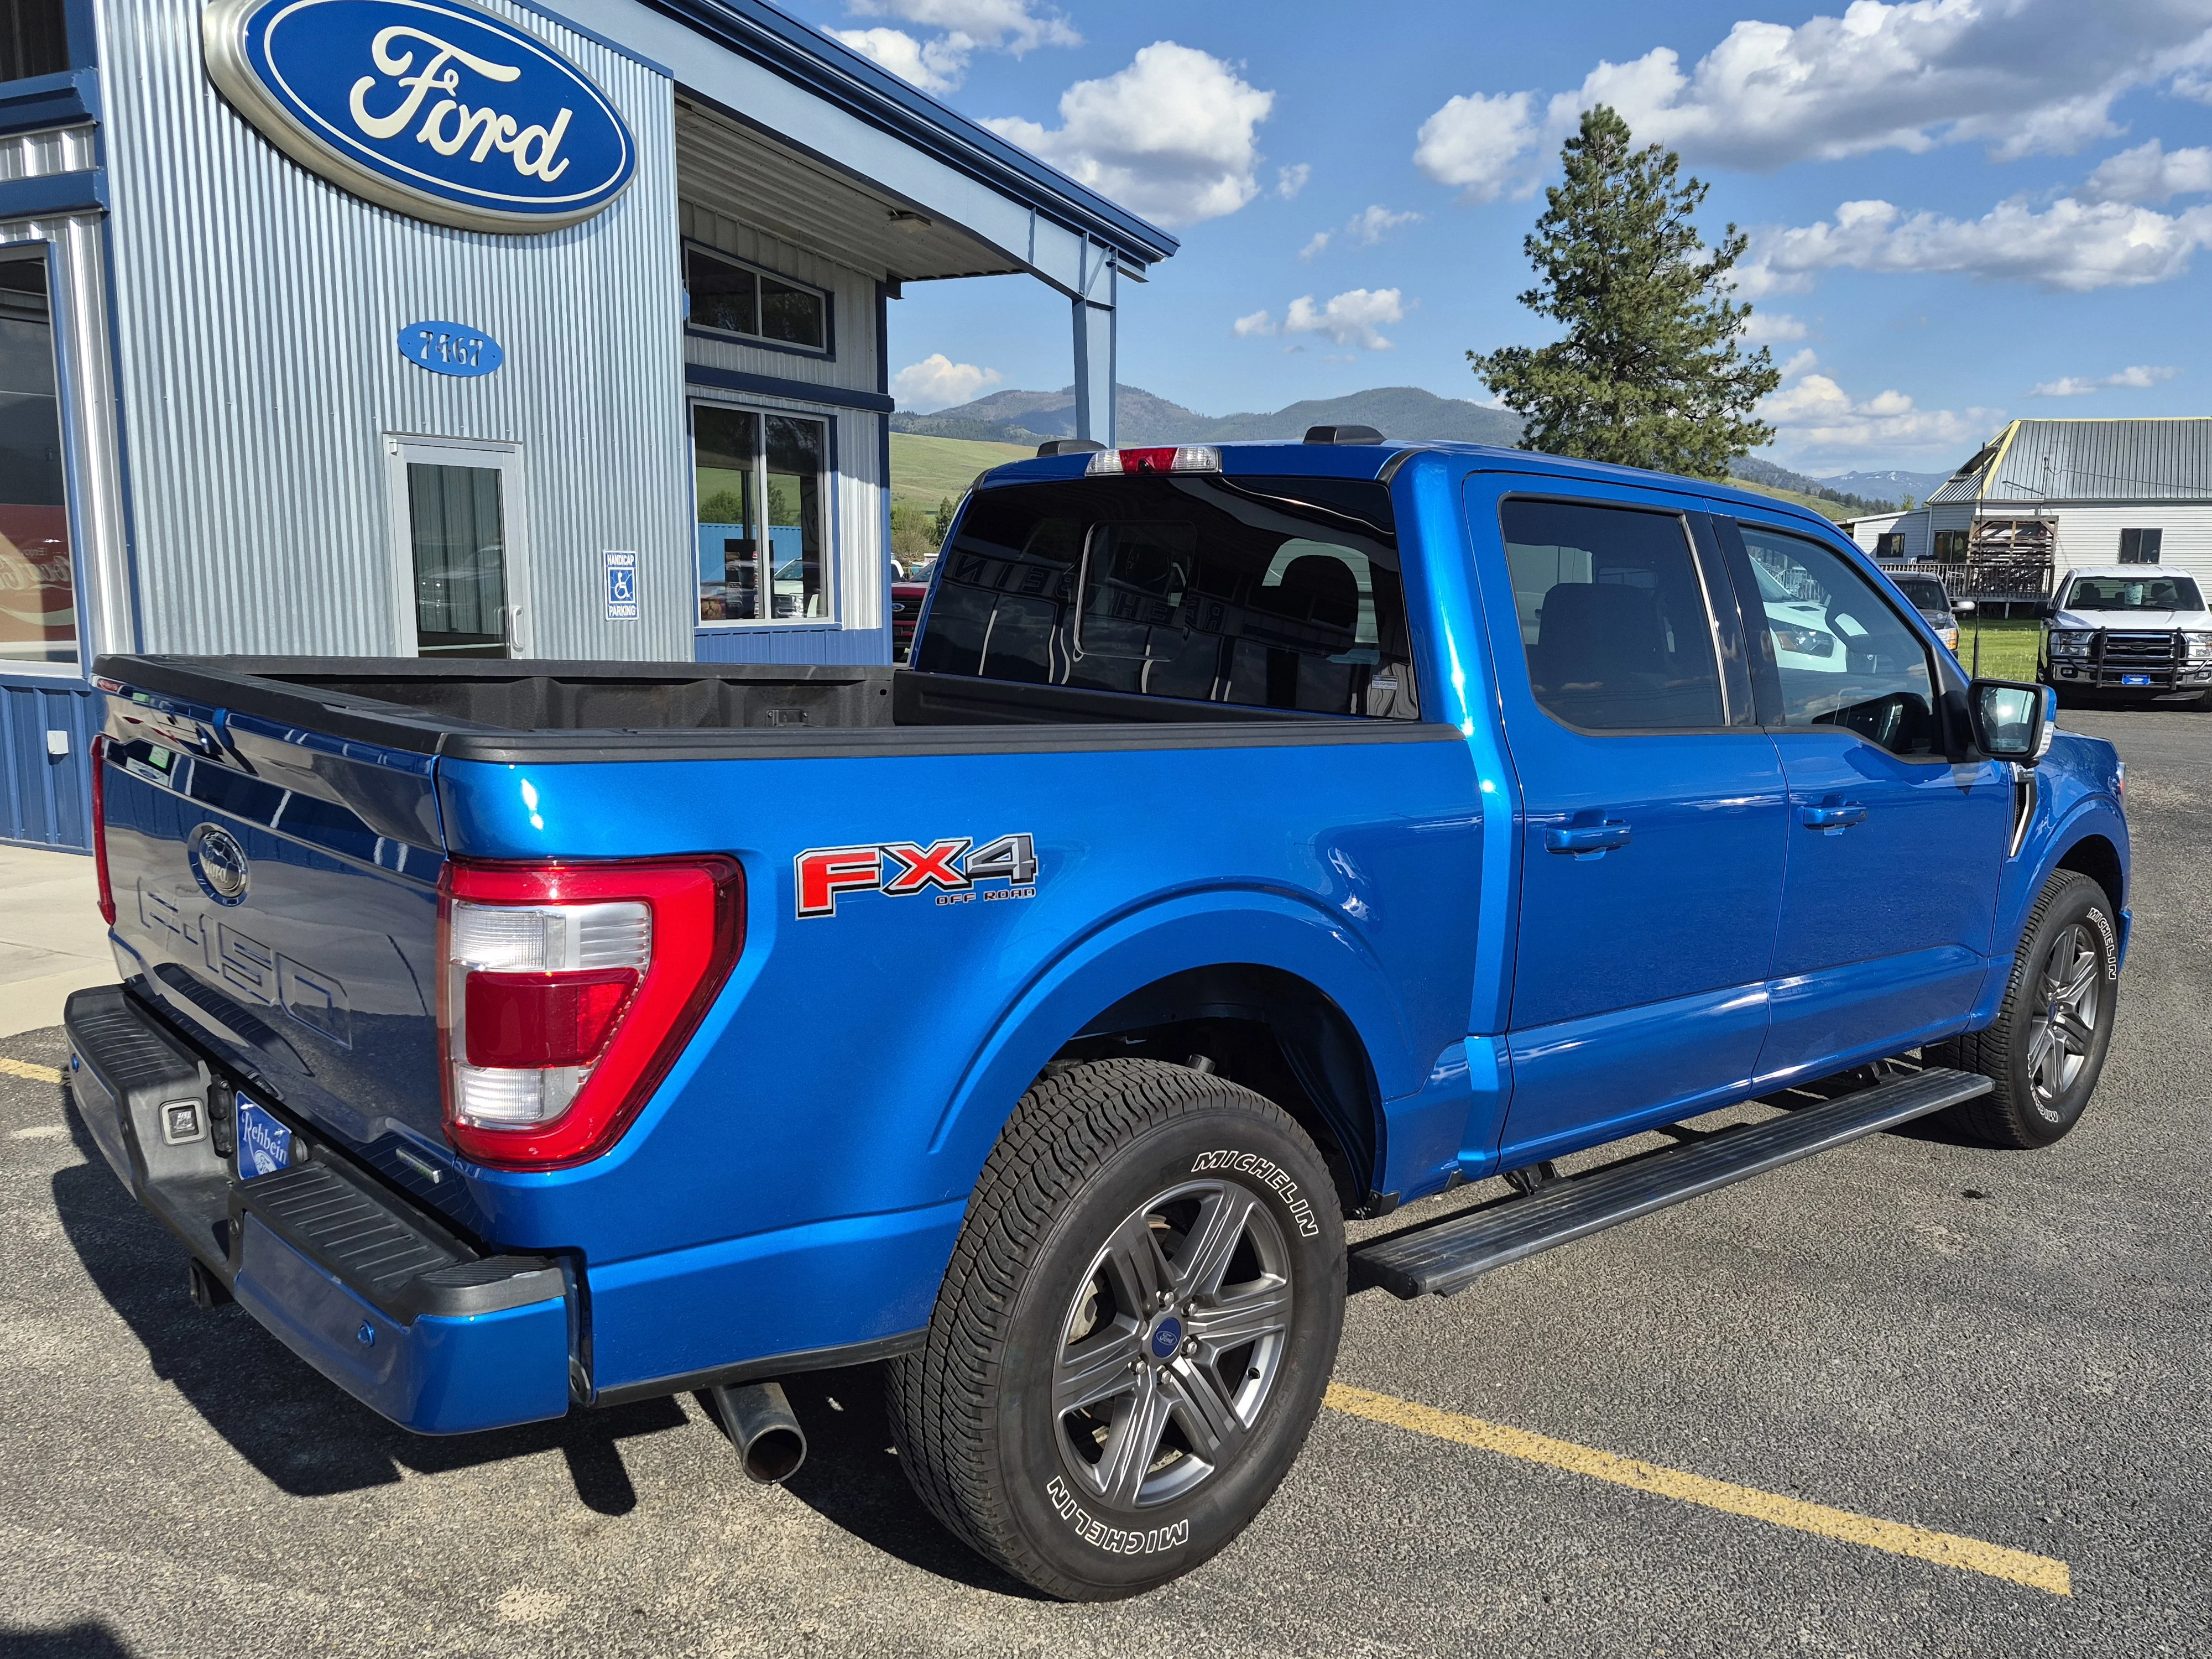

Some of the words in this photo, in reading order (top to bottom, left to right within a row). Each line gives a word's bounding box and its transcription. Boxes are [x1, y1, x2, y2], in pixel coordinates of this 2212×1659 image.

[349, 25, 573, 182] Ford
[419, 330, 484, 367] 7467
[607, 554, 635, 566] HANDICAP
[609, 604, 637, 617] PARKING
[794, 832, 1039, 921] FX4
[936, 892, 977, 906] OFF
[983, 886, 1036, 901] ROAD
[137, 875, 353, 1050] F-150
[2086, 907, 2117, 980] MICHELIN
[241, 1110, 287, 1165] Rehbein
[1191, 1150, 1319, 1237] MICHELIN
[1159, 1332, 1175, 1344] Ford
[1046, 1474, 1188, 1555] MICHELIN
